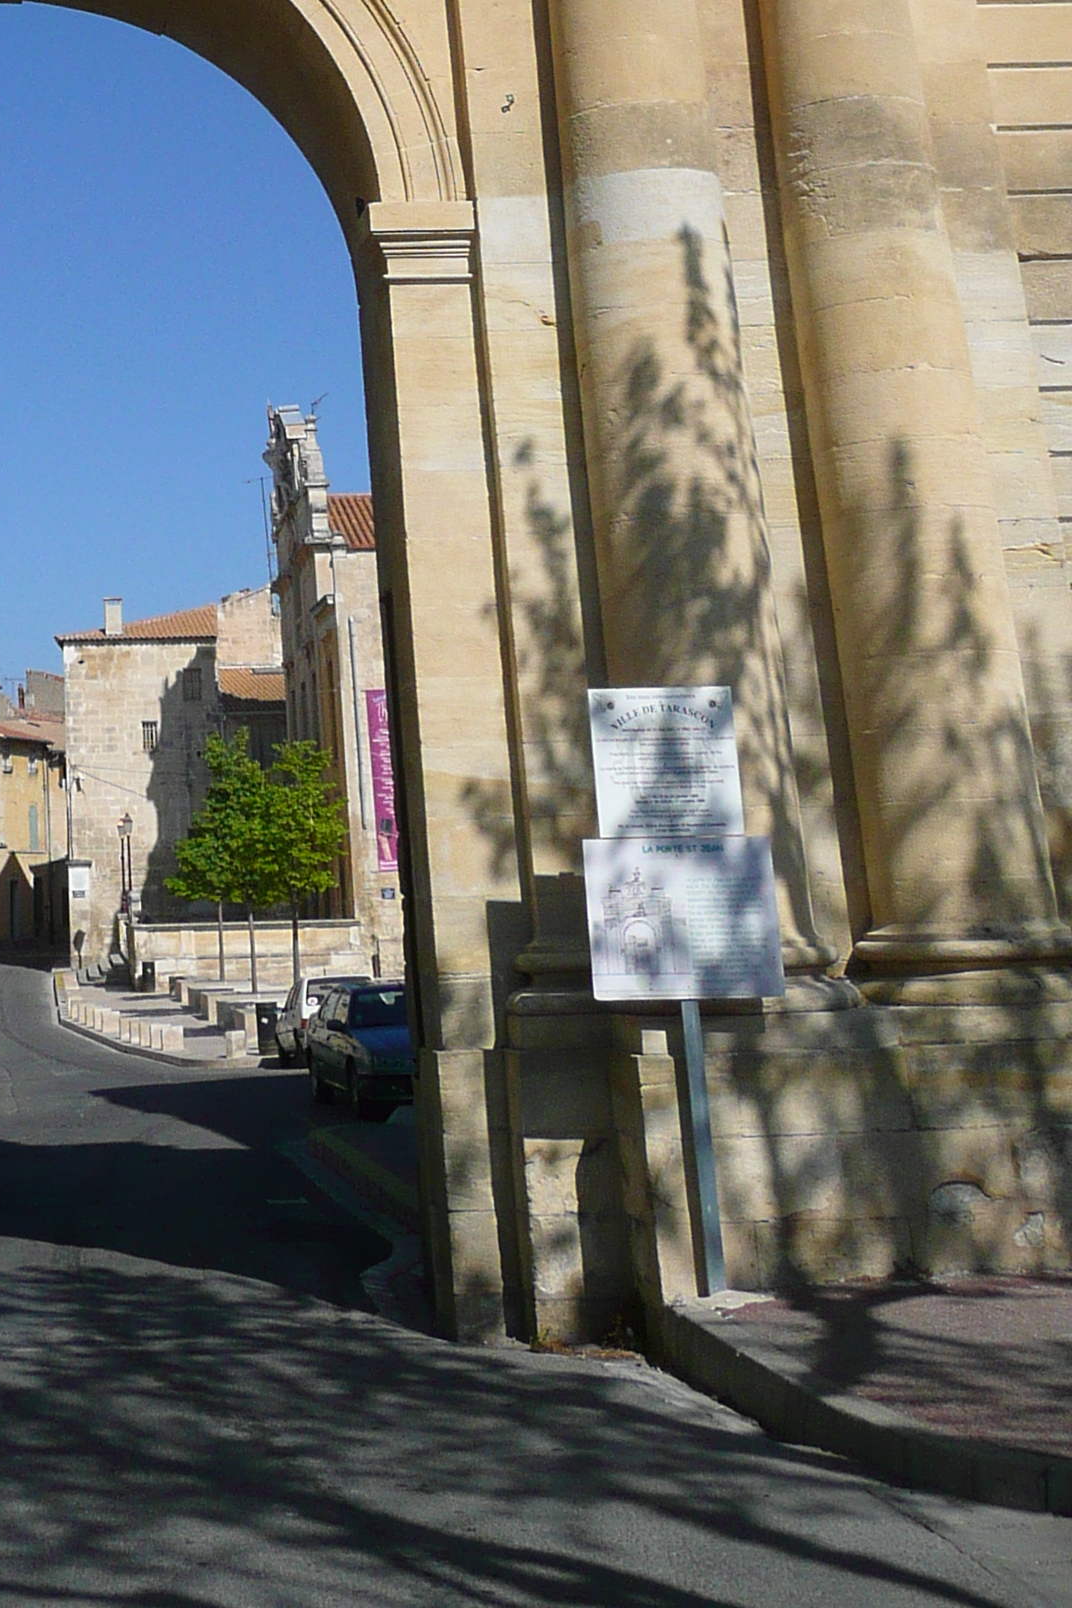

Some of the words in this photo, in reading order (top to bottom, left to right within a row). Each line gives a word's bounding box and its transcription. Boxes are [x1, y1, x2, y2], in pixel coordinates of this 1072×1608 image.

[610, 709, 639, 730] VILLE
[642, 704, 658, 714] DE
[659, 703, 715, 729] TARASCON
[642, 845, 654, 853] LA
[656, 844, 683, 853] PORTE
[686, 844, 697, 853] ST
[700, 843, 725, 853] JEAN
